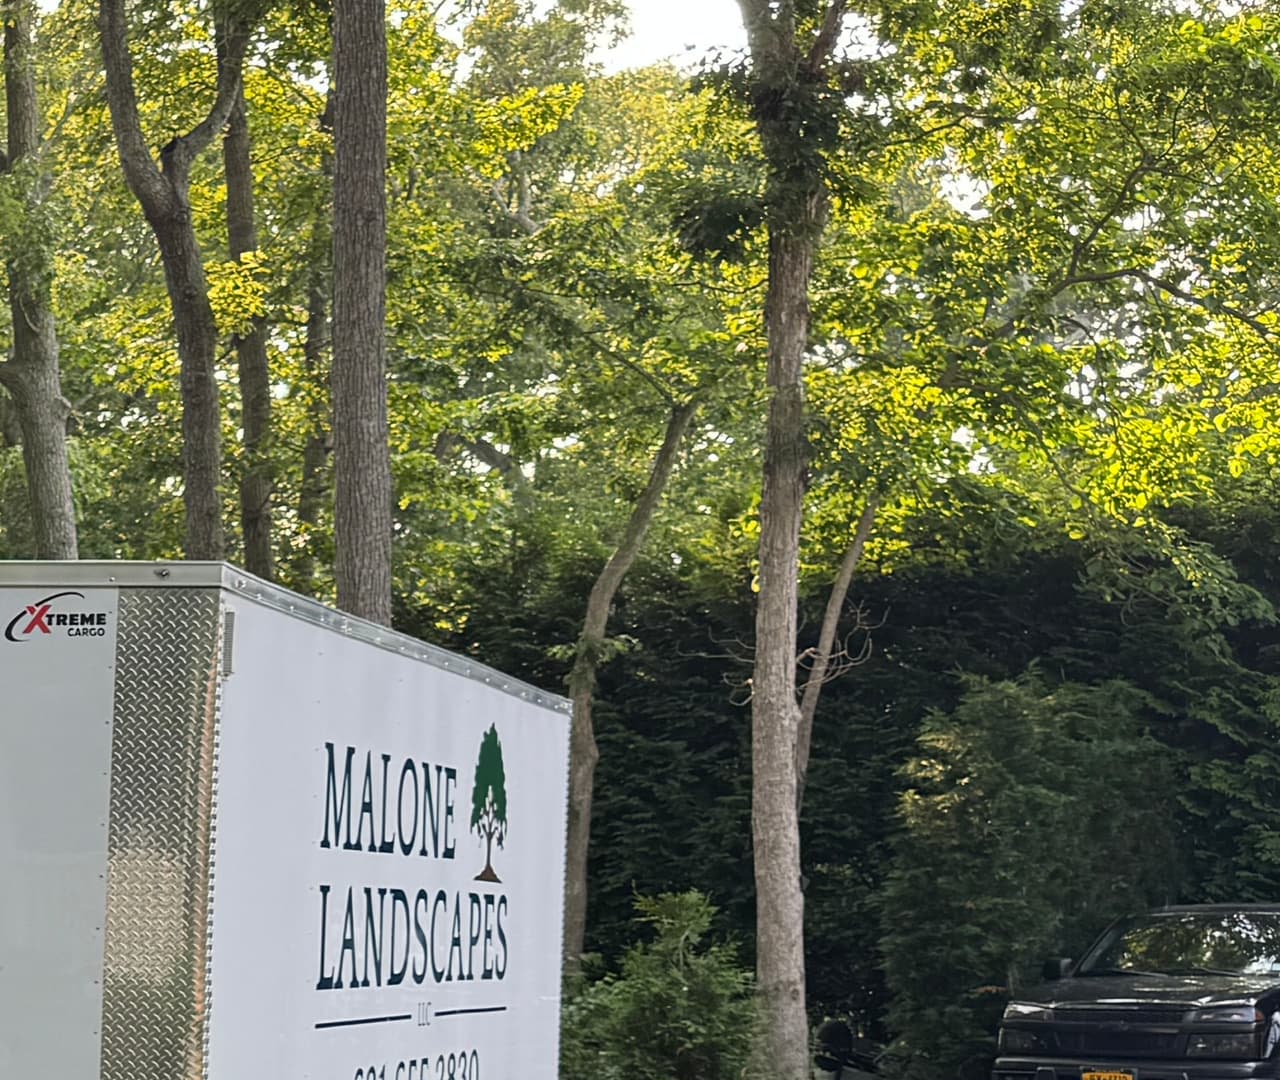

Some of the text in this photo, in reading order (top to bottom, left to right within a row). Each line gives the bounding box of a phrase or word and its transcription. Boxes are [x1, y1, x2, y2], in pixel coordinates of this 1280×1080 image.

[22, 604, 107, 634] XTREME
[67, 627, 106, 637] CARGO
[320, 742, 457, 860] MALONE
[316, 885, 508, 991] LANDSCAPES
[417, 1001, 432, 1027] LLC
